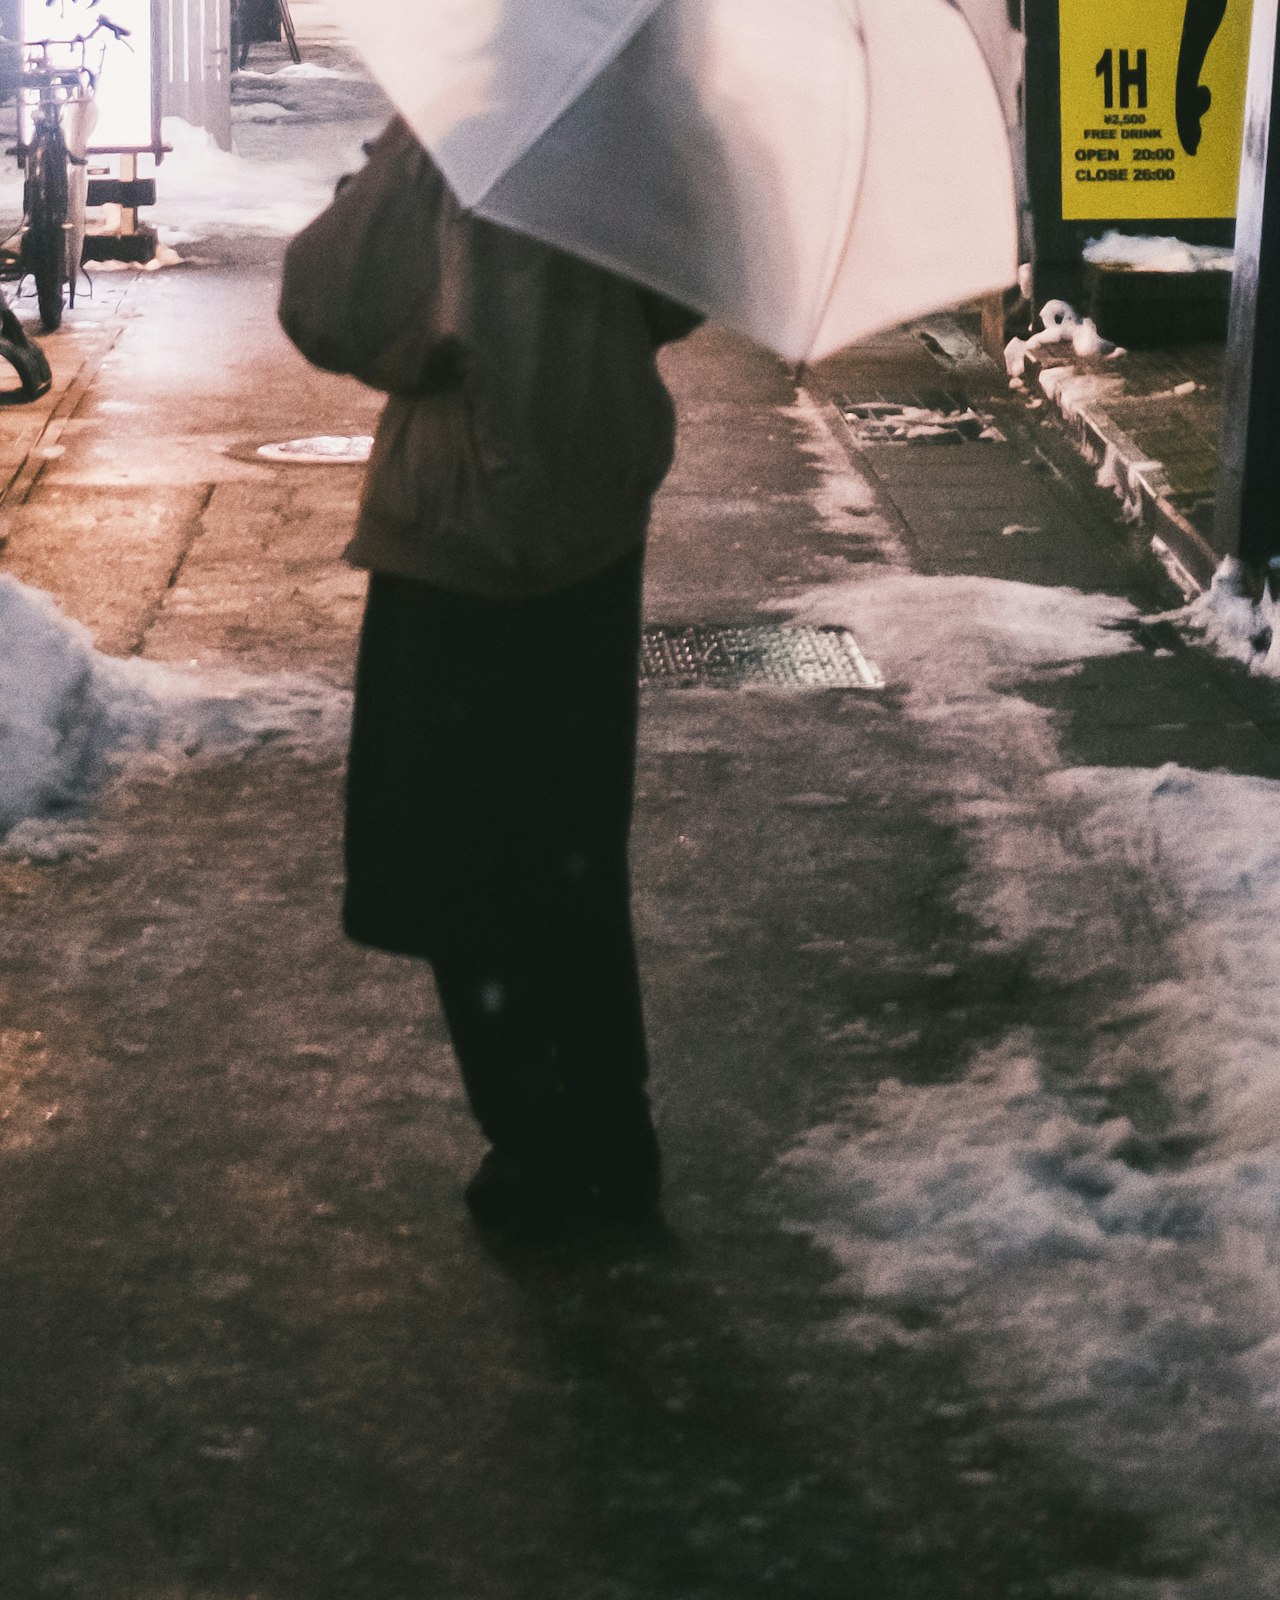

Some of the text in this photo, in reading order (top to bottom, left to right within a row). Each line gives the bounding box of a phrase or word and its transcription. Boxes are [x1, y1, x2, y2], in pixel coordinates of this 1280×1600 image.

[1094, 48, 1148, 109] 1H
[1083, 129, 1118, 140] FREE
[1074, 148, 1176, 161] OPEN 20:00
[1074, 168, 1129, 181] CLOSE
